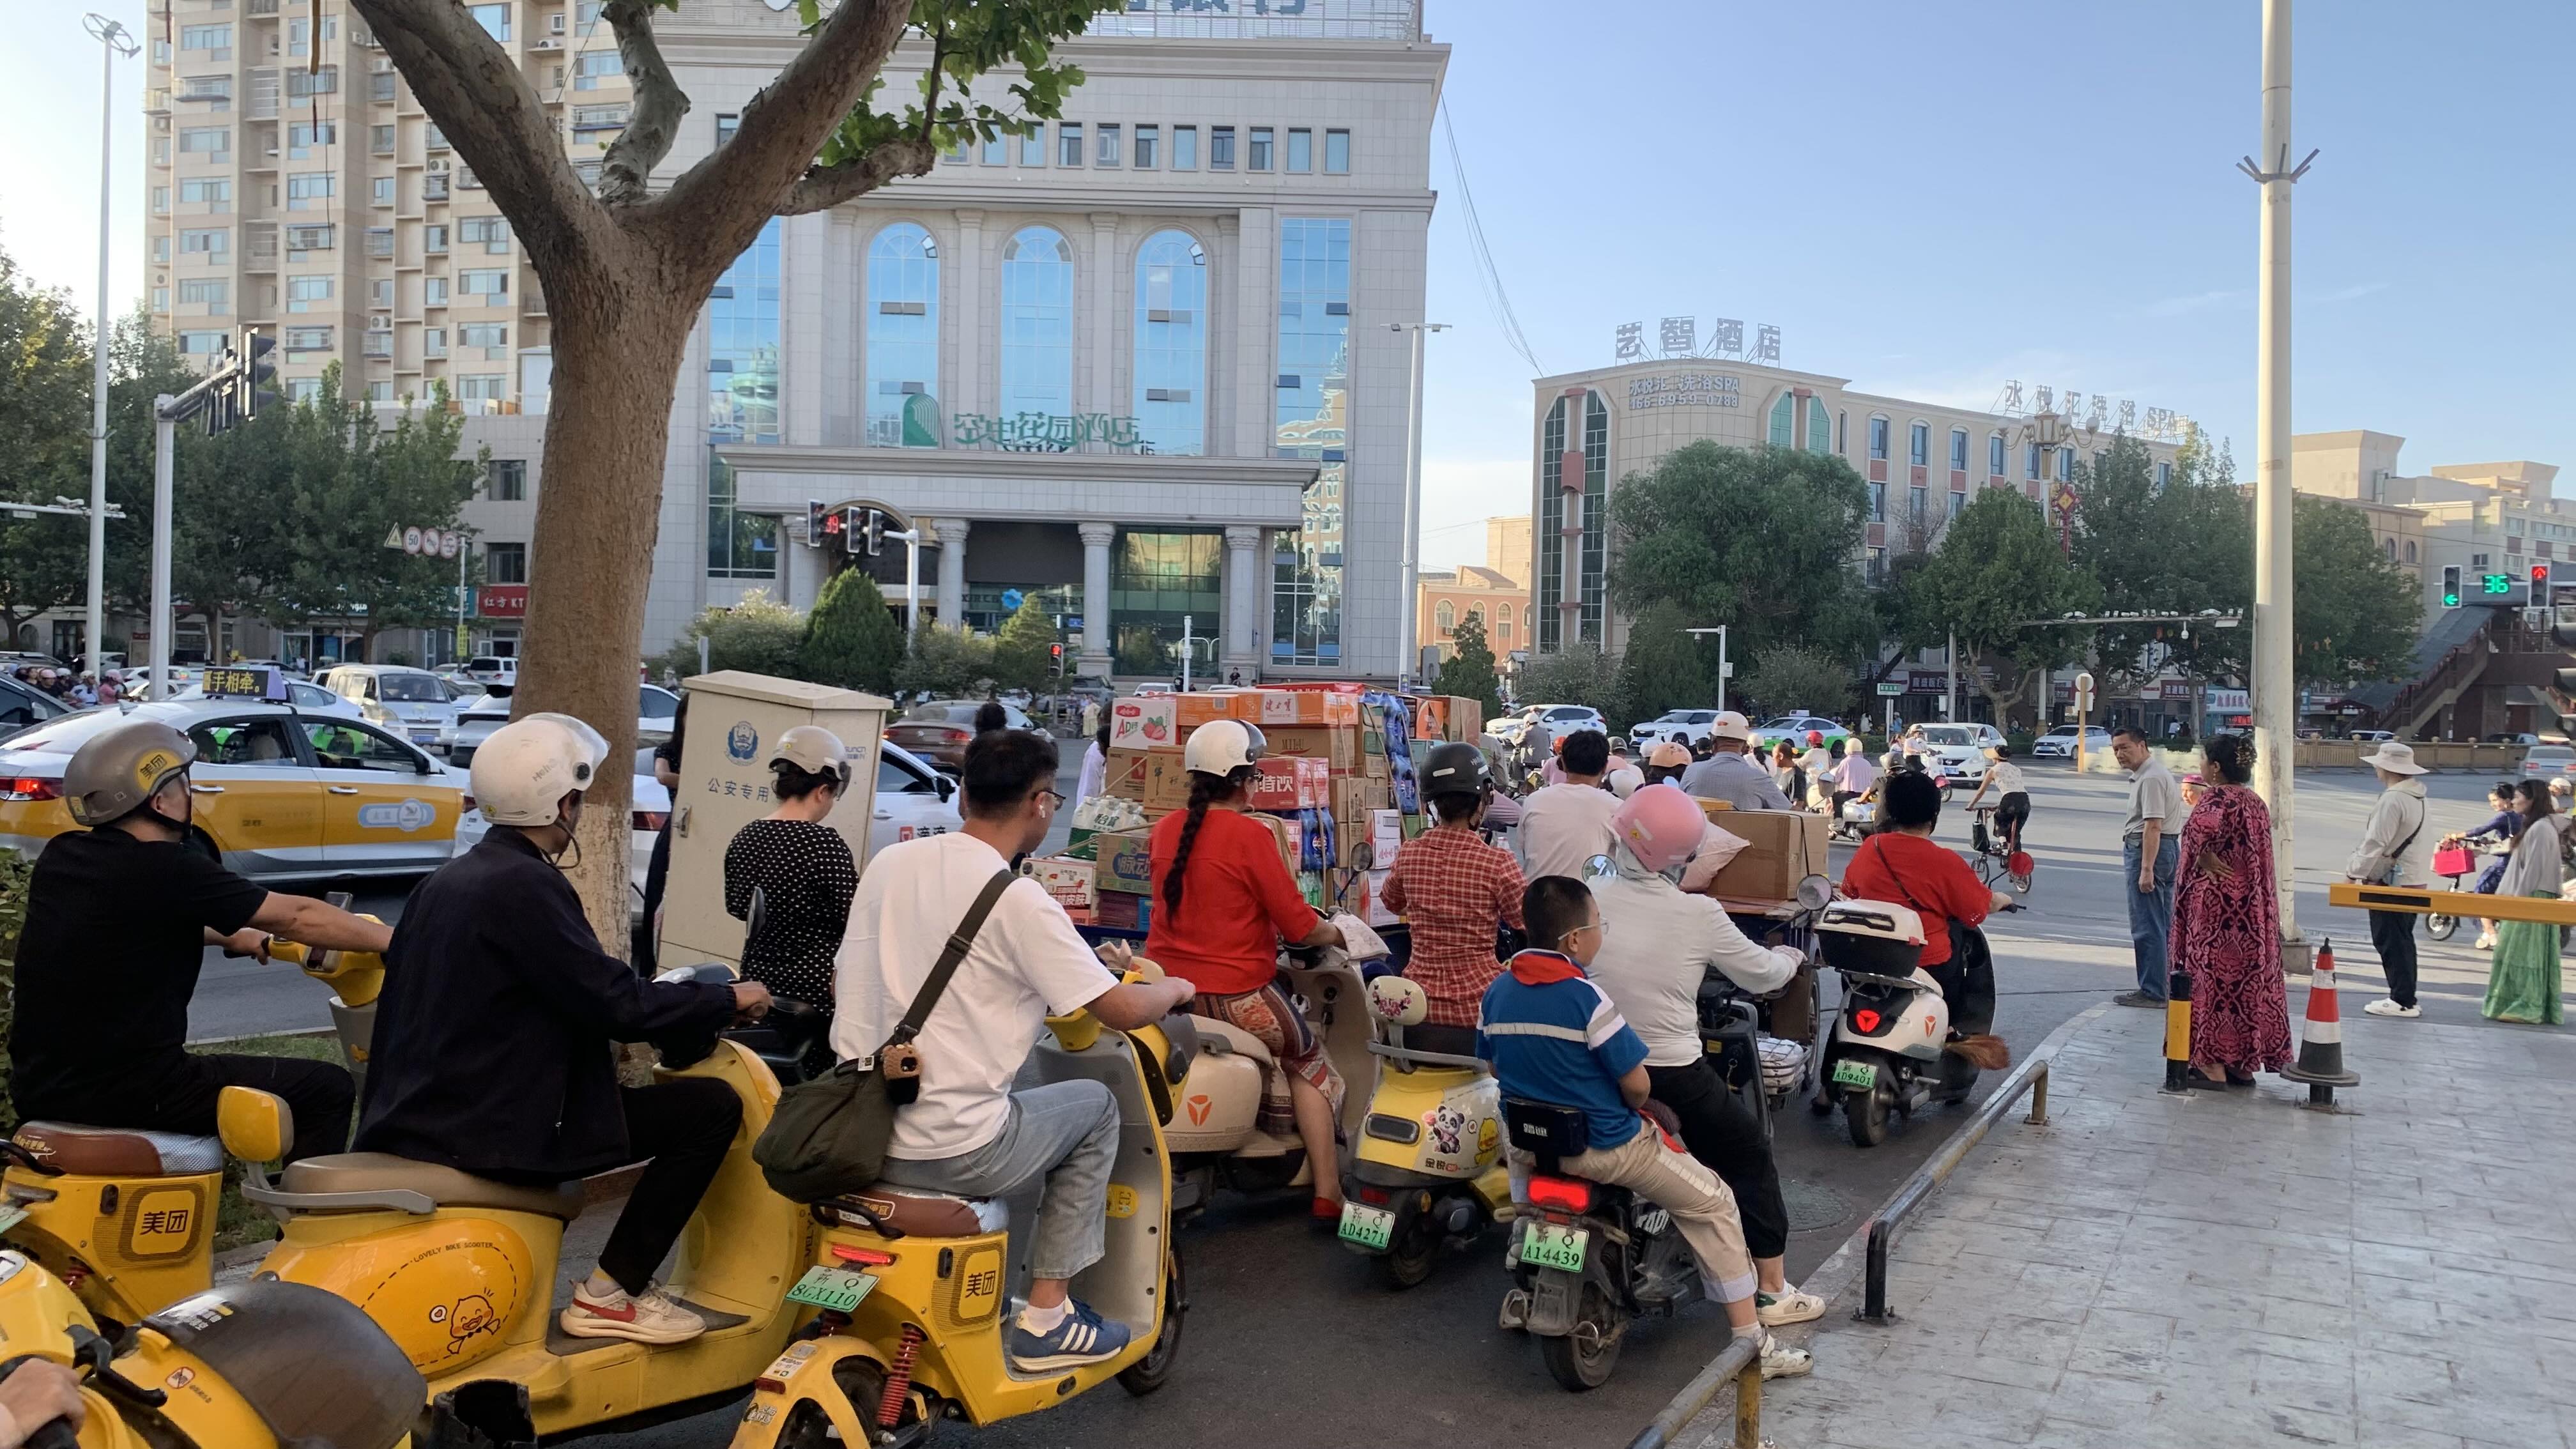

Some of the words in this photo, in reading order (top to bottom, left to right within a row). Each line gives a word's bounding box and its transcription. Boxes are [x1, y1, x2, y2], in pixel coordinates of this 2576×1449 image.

[1616, 317, 1780, 360] 艺智酒店
[1630, 396, 1651, 409] 166
[1659, 392, 1697, 406] 6959
[1706, 392, 1738, 408] 0788
[954, 411, 1140, 447] 空中花园酒店
[409, 535, 418, 546] 50
[2484, 574, 2509, 594] 36
[141, 755, 167, 780] 美团
[708, 777, 769, 803] 公安专用
[1256, 776, 1294, 793] 特饮
[1835, 1072, 1871, 1085] AD9401
[139, 1210, 188, 1235] 美团
[1373, 1216, 1382, 1229] Q
[1342, 1223, 1385, 1244] AD4271
[1562, 1234, 1574, 1248] Q
[413, 1247, 441, 1262] LOVELY
[1524, 1246, 1579, 1266] A14439
[844, 1278, 859, 1290] Q
[965, 1270, 996, 1298] 美团
